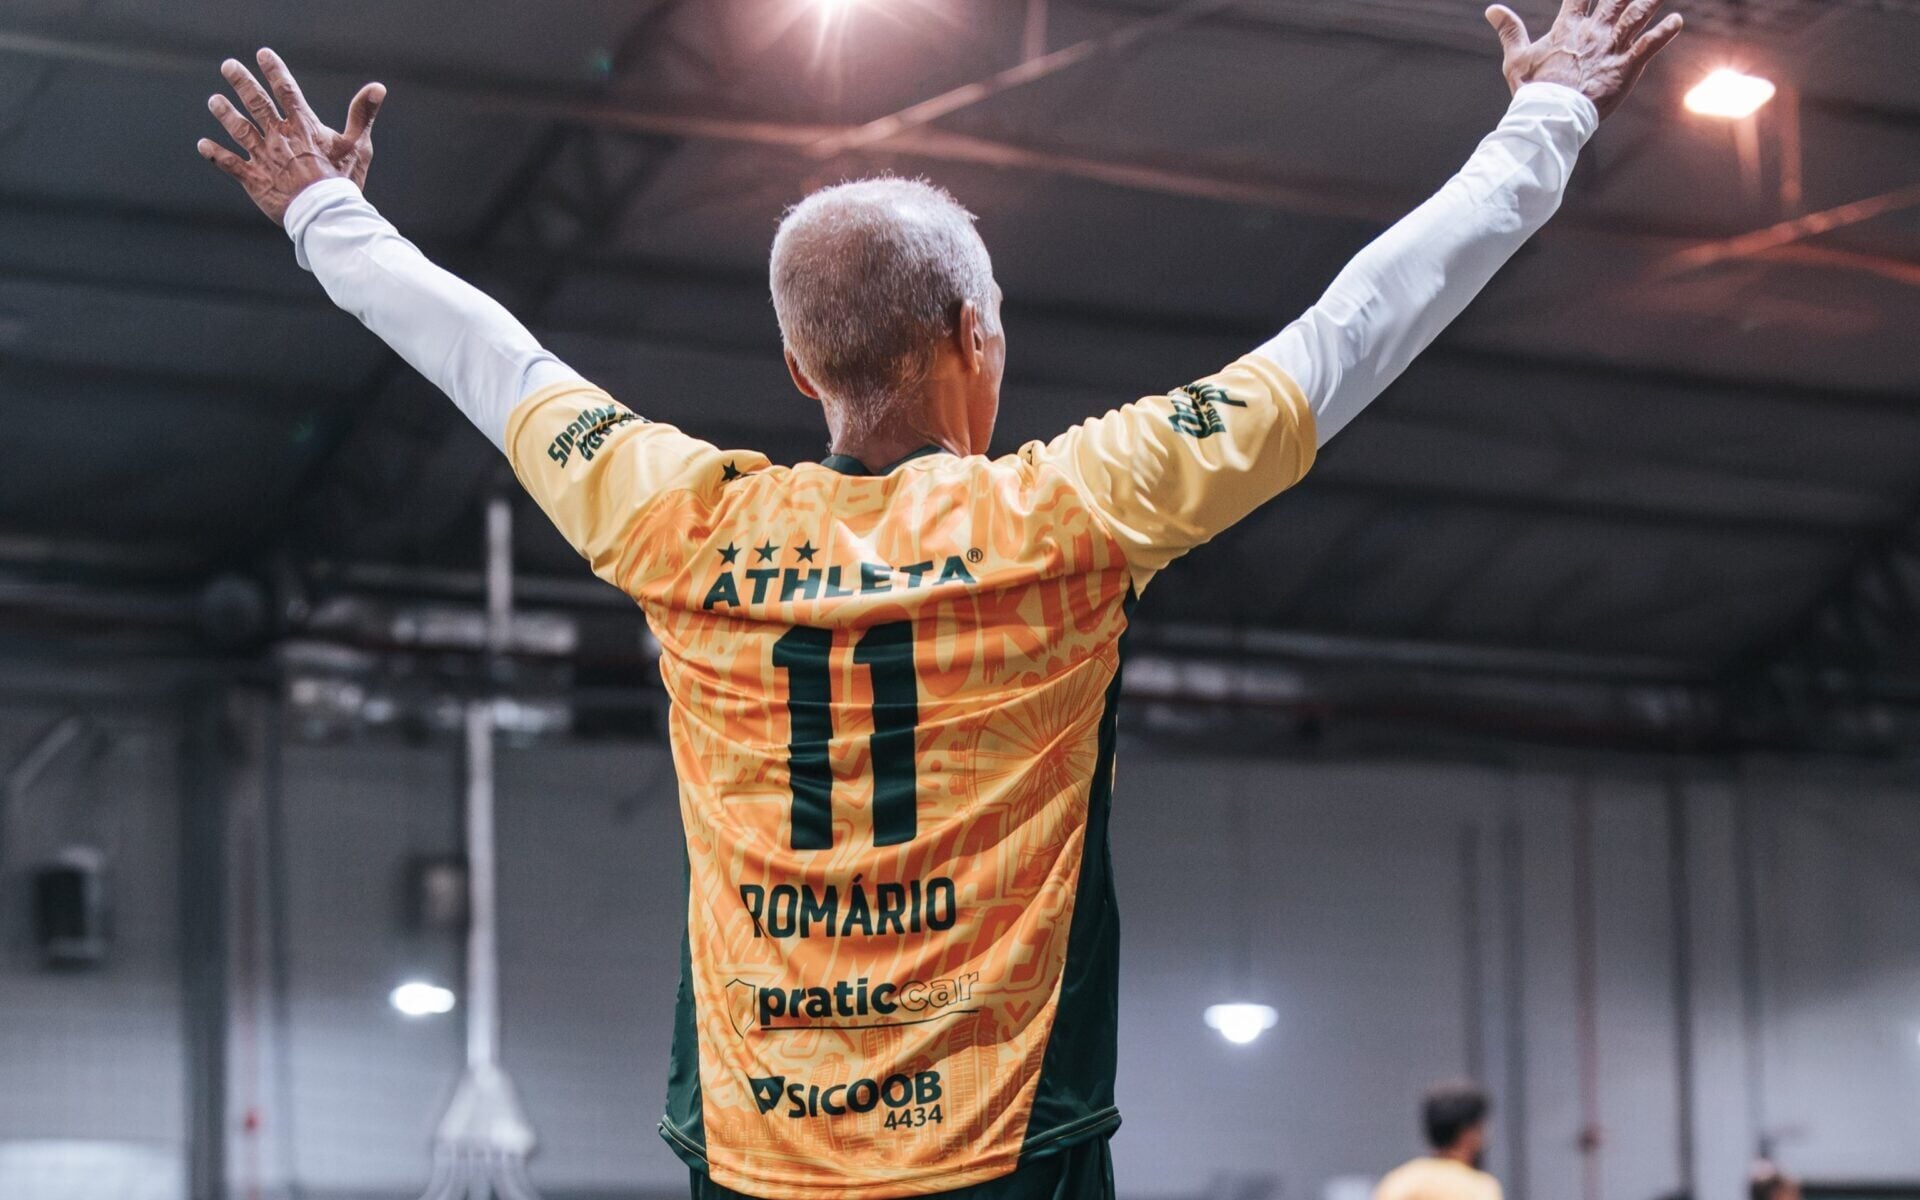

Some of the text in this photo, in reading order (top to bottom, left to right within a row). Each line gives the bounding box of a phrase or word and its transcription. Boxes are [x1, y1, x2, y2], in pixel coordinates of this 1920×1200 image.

[772, 619, 919, 851] 11
[739, 873, 957, 939] ROMÁRIO
[787, 1070, 943, 1118] SICOOB
[883, 1104, 944, 1131] 4434
